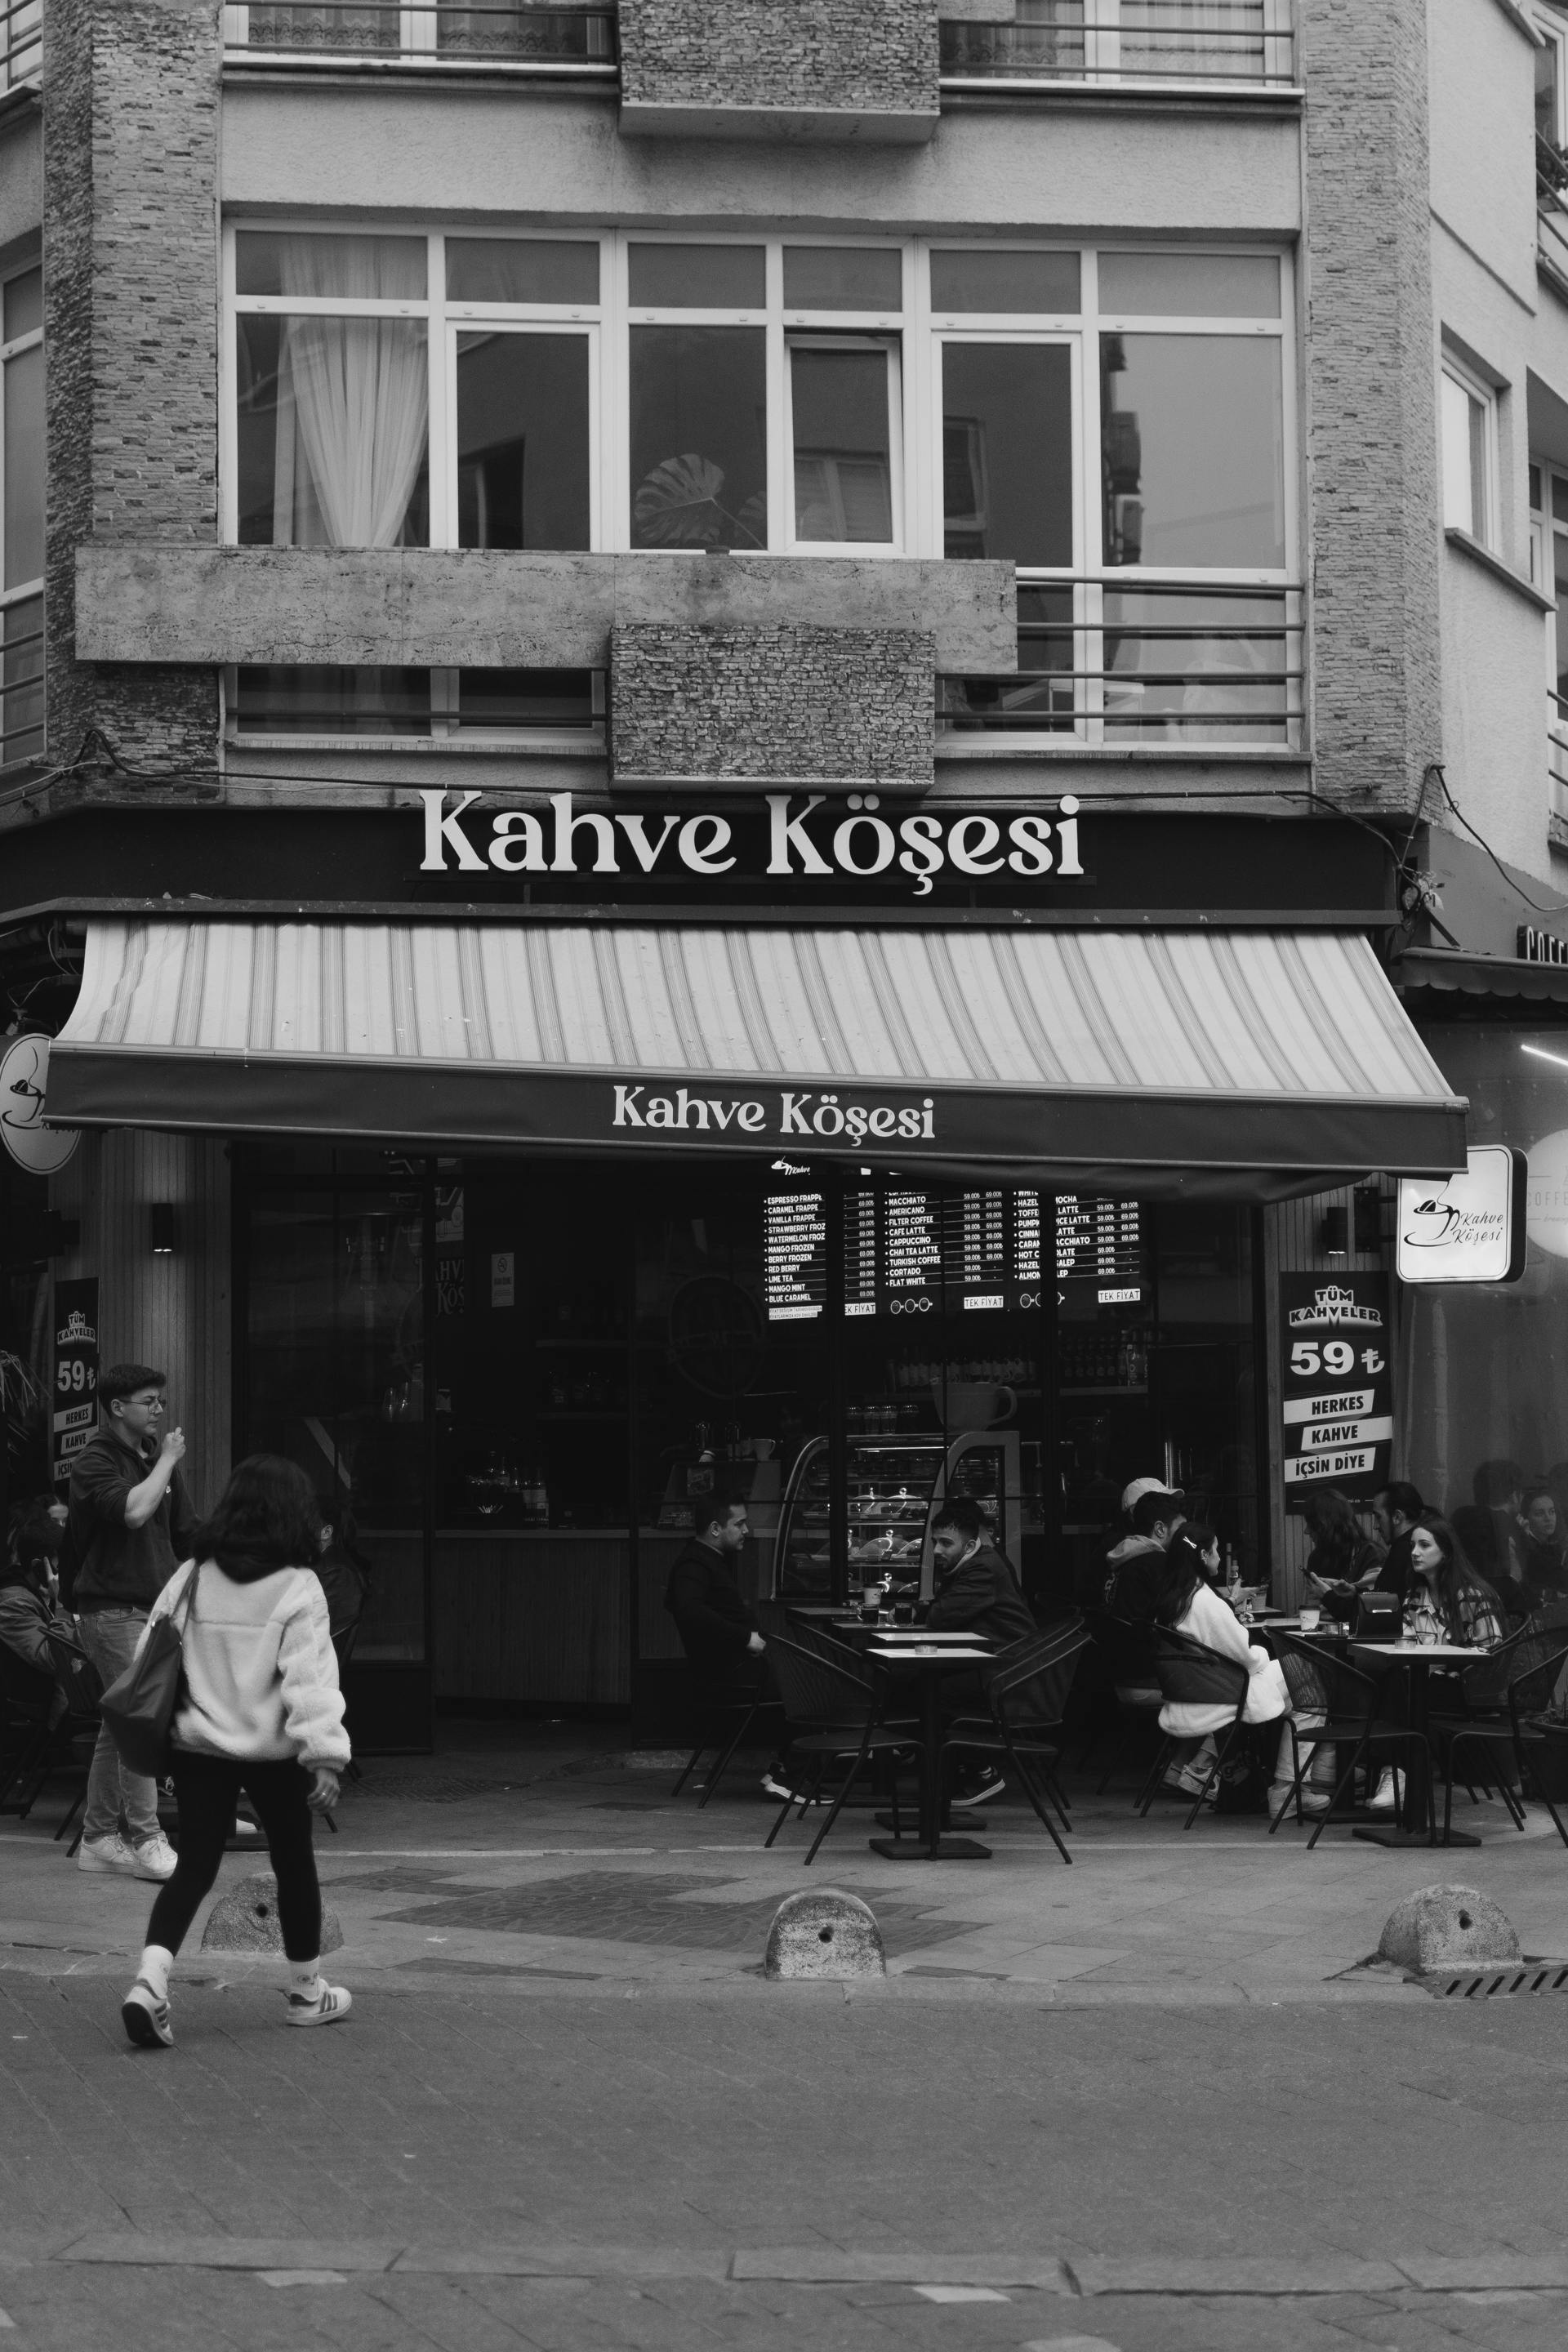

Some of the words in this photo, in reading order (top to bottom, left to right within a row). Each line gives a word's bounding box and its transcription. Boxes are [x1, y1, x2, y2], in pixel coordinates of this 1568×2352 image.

[420, 791, 737, 874] Kahve
[765, 794, 1084, 895] Köşesi
[612, 1085, 766, 1131] Kahve
[780, 1093, 935, 1147] Köşesi
[768, 1196, 799, 1205] ESPRESSO
[889, 1196, 926, 1206] MACCHIATO
[1018, 1198, 1038, 1207] HAZEL
[795, 1204, 818, 1212] FRAPPE
[889, 1206, 925, 1216] AMERICANO
[1058, 1205, 1079, 1214] LATTE
[793, 1214, 815, 1222] FRAPPE
[889, 1218, 909, 1226] FILTER
[910, 1216, 933, 1224] COFFEE
[1069, 1215, 1090, 1223] LATTE
[1460, 1211, 1503, 1226] Kahve
[768, 1224, 808, 1234] STRAWBERRY
[768, 1234, 808, 1244] WATERMELON
[889, 1236, 931, 1246] CAPPUCCINO
[1453, 1227, 1503, 1245] Köşesi
[768, 1245, 790, 1254] MANGO
[791, 1244, 815, 1252] FROZEN
[919, 1245, 938, 1254] LATTE
[1018, 1250, 1032, 1258] HOT
[768, 1255, 787, 1263] BERRY
[789, 1254, 812, 1262] FROZEN
[889, 1258, 916, 1266] TURKISH
[917, 1256, 941, 1264] COFFEE
[781, 1264, 800, 1272] BERRY
[1018, 1261, 1040, 1269] HAZEL
[889, 1267, 920, 1276] CORTADO
[890, 1279, 905, 1287] FLAT
[906, 1277, 925, 1285] WHITE
[769, 1285, 791, 1293] MANGO
[1316, 1285, 1352, 1302] TÜM
[785, 1294, 811, 1302] CARAMEL
[1098, 1292, 1114, 1301] TEK
[965, 1298, 979, 1307] TEK
[70, 1312, 85, 1324] TÜM
[1290, 1306, 1381, 1324] KAHVELER
[58, 1327, 95, 1342] KAHVELER
[1312, 1396, 1364, 1415] HERKES
[65, 1408, 89, 1425] HERKES
[1312, 1425, 1358, 1444] KAHVE
[65, 1432, 87, 1449] KAHVE
[1296, 1457, 1330, 1479] İÇSİN
[1335, 1453, 1365, 1471] DİYE
